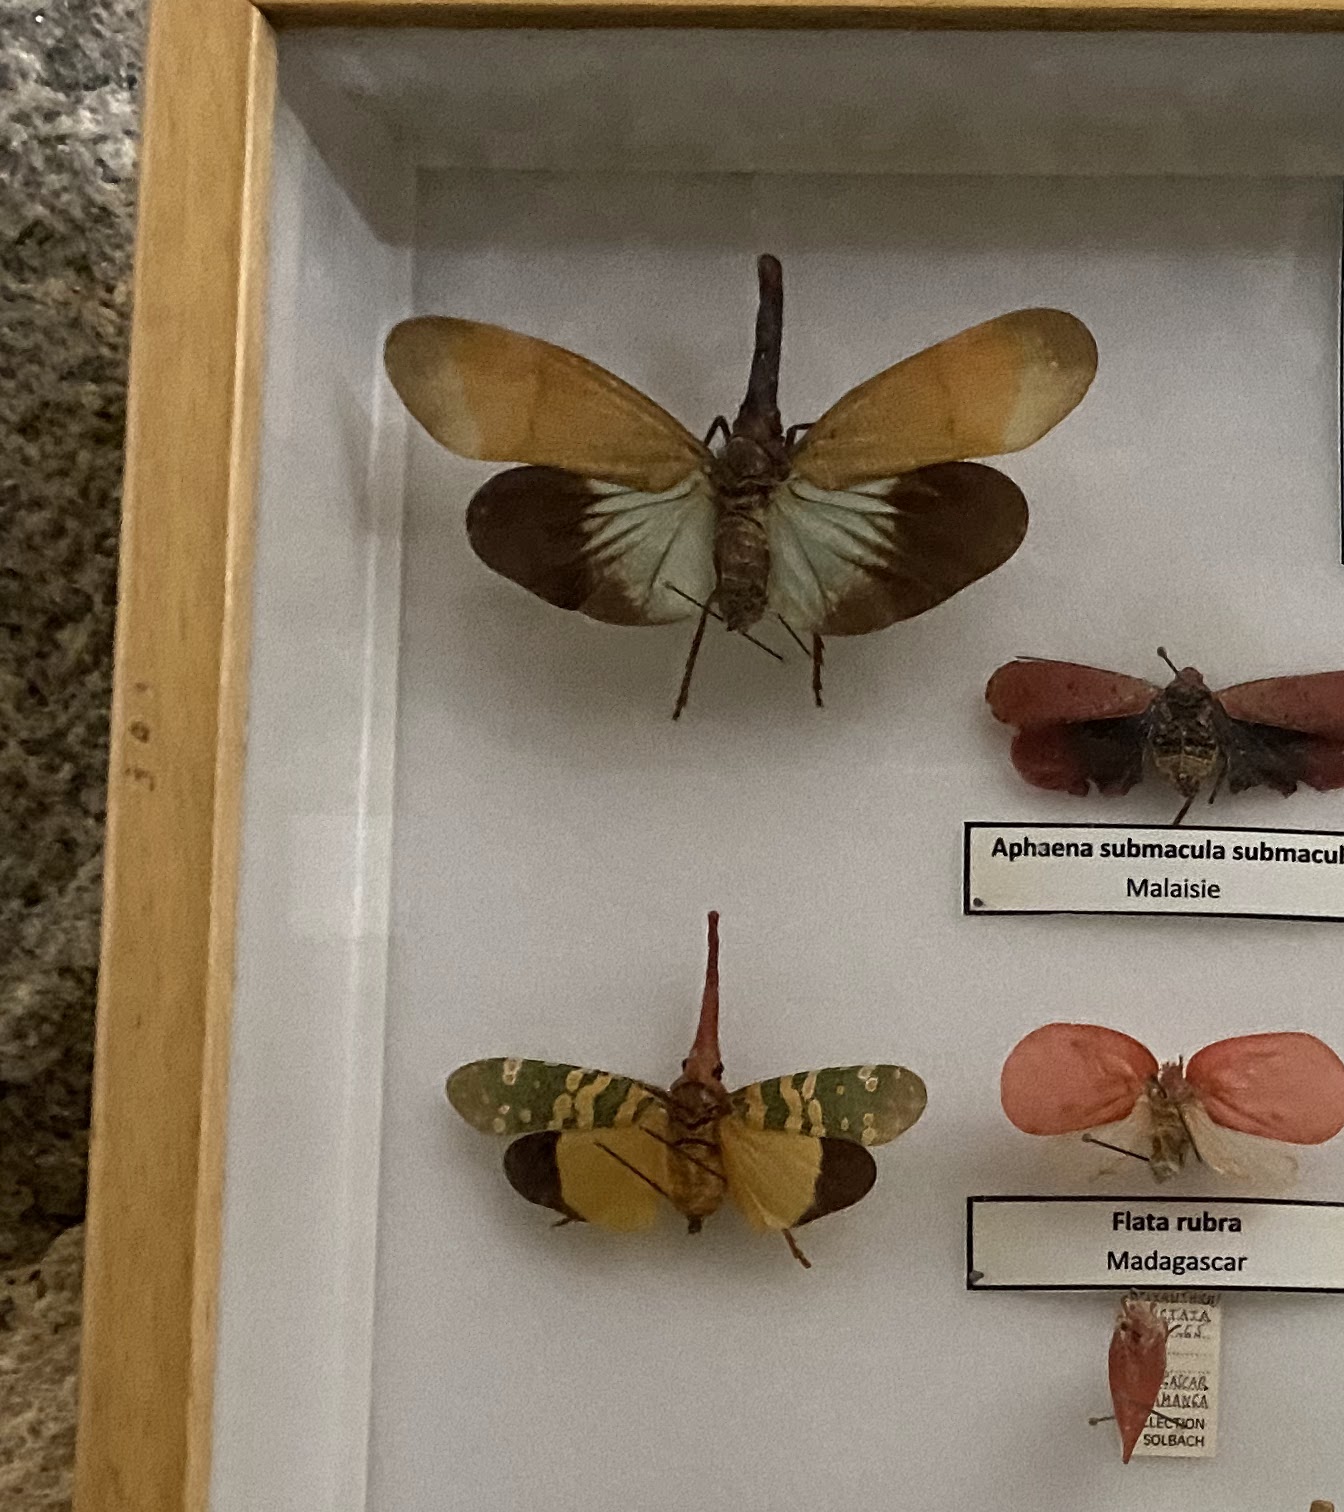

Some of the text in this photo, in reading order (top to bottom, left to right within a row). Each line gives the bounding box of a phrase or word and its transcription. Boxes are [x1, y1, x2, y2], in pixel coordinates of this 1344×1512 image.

[991, 836, 1094, 863] Aphaena
[1100, 838, 1226, 861] submacula
[1126, 876, 1222, 900] Malaisie
[1112, 1210, 1243, 1234] Flata rubra
[1107, 1250, 1249, 1276] Madagascar
[1146, 1416, 1205, 1430] LECTION
[1143, 1433, 1205, 1447] SOLBACH
